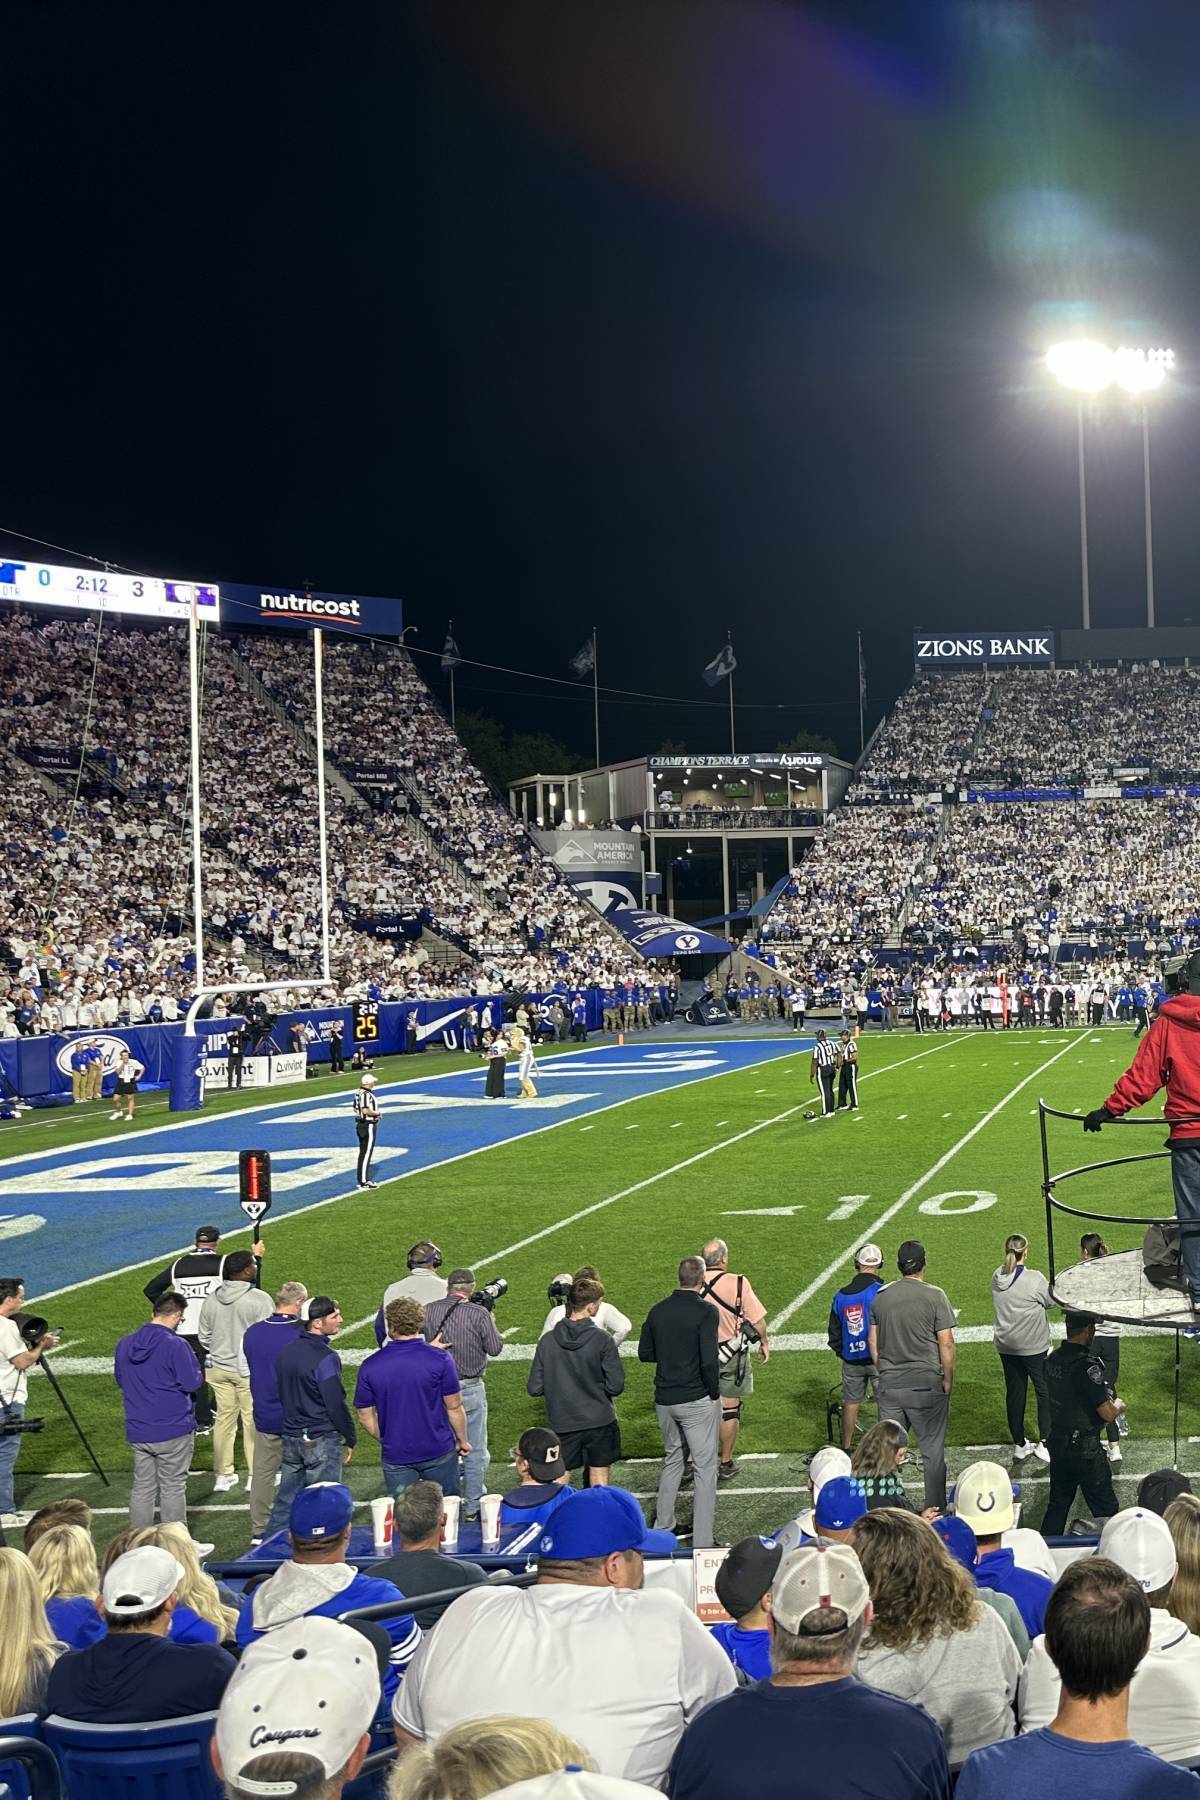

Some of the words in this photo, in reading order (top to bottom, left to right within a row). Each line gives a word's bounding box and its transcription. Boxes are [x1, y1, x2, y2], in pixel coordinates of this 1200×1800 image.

[38, 569, 51, 586] 0
[76, 576, 109, 593] 2:12
[132, 582, 145, 597] 3
[260, 593, 360, 616] nutricost
[917, 639, 983, 657] ZIONS
[989, 638, 1050, 656] BANK
[38, 755, 60, 764] Portal
[650, 756, 705, 766] CHAMPIONS
[706, 756, 749, 766] TERRACE
[593, 842, 634, 851] MOUNTAIN
[597, 851, 633, 860] AMERICA
[357, 1016, 375, 1038] 25
[215, 1062, 254, 1076] vivnt
[250, 1725, 321, 1748] Cougars
